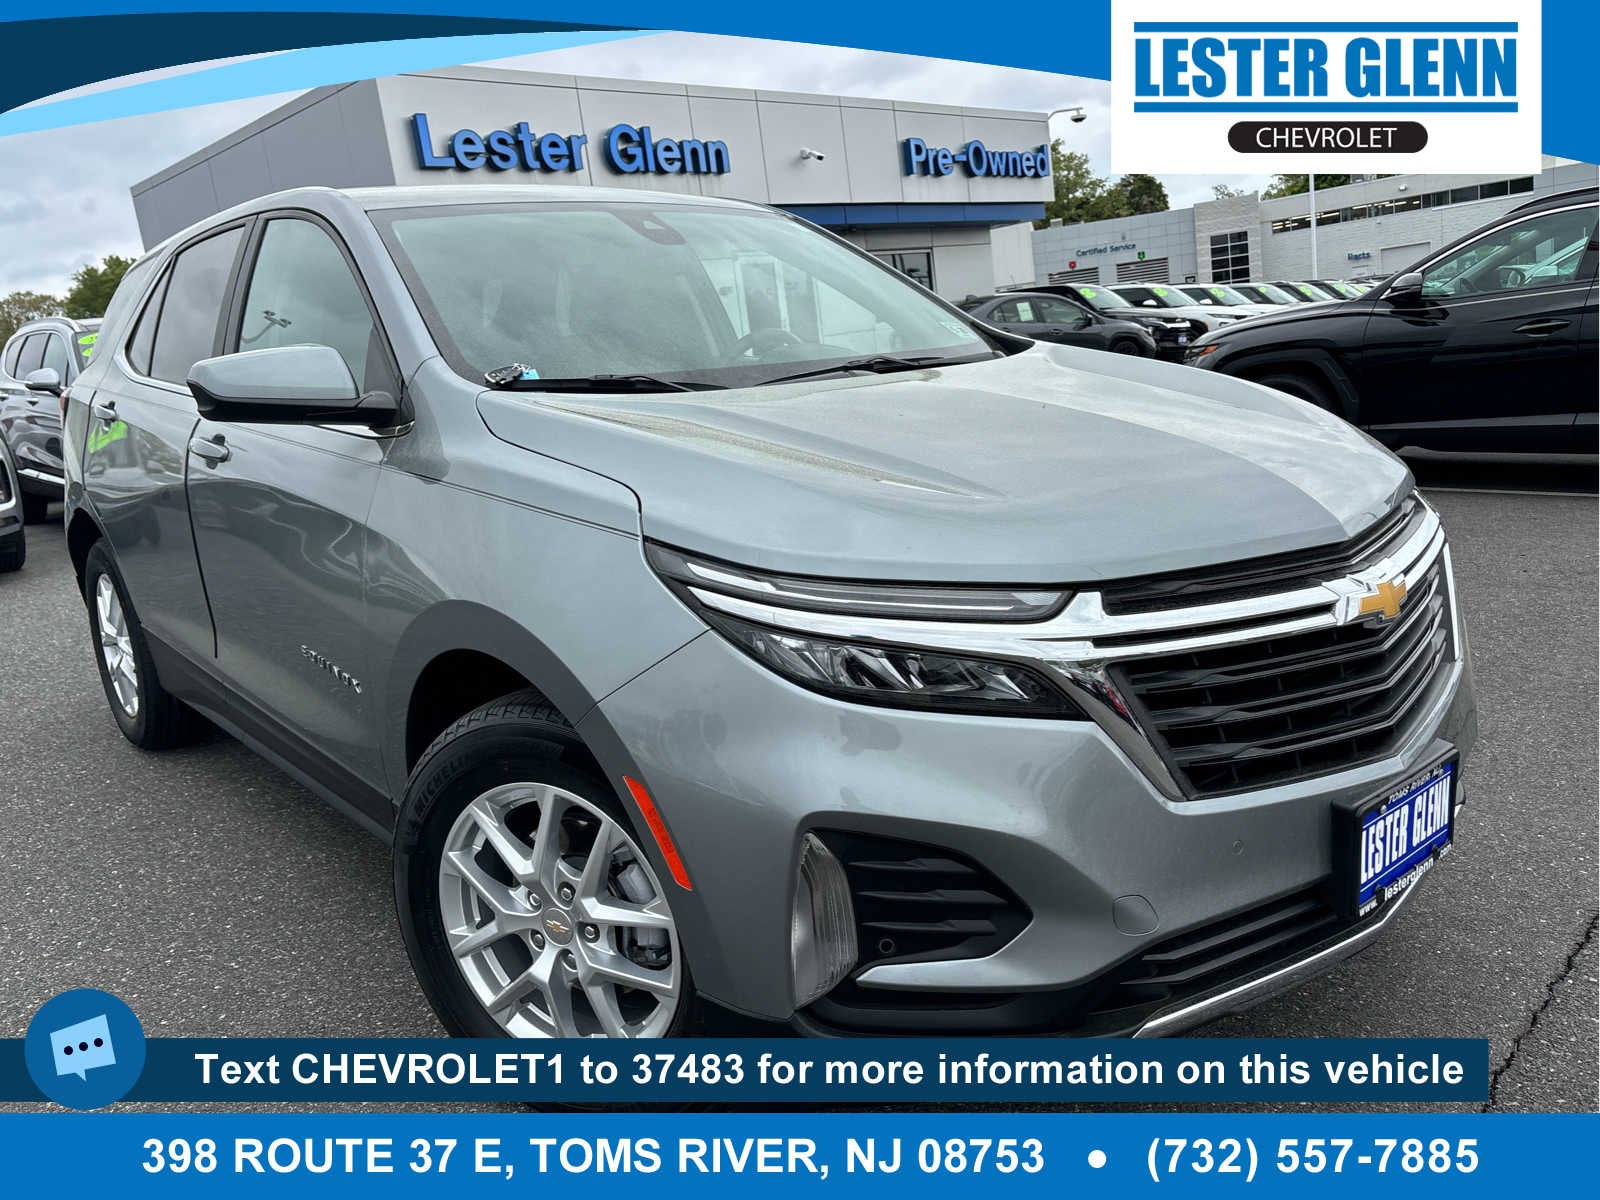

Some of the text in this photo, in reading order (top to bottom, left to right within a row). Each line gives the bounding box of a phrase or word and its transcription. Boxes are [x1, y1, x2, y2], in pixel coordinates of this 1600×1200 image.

[410, 112, 732, 176] Lester Glenn
[903, 137, 1050, 178] Pre-Owned
[1076, 243, 1136, 257] Certified Service
[1360, 775, 1451, 885] LESTER GLENN
